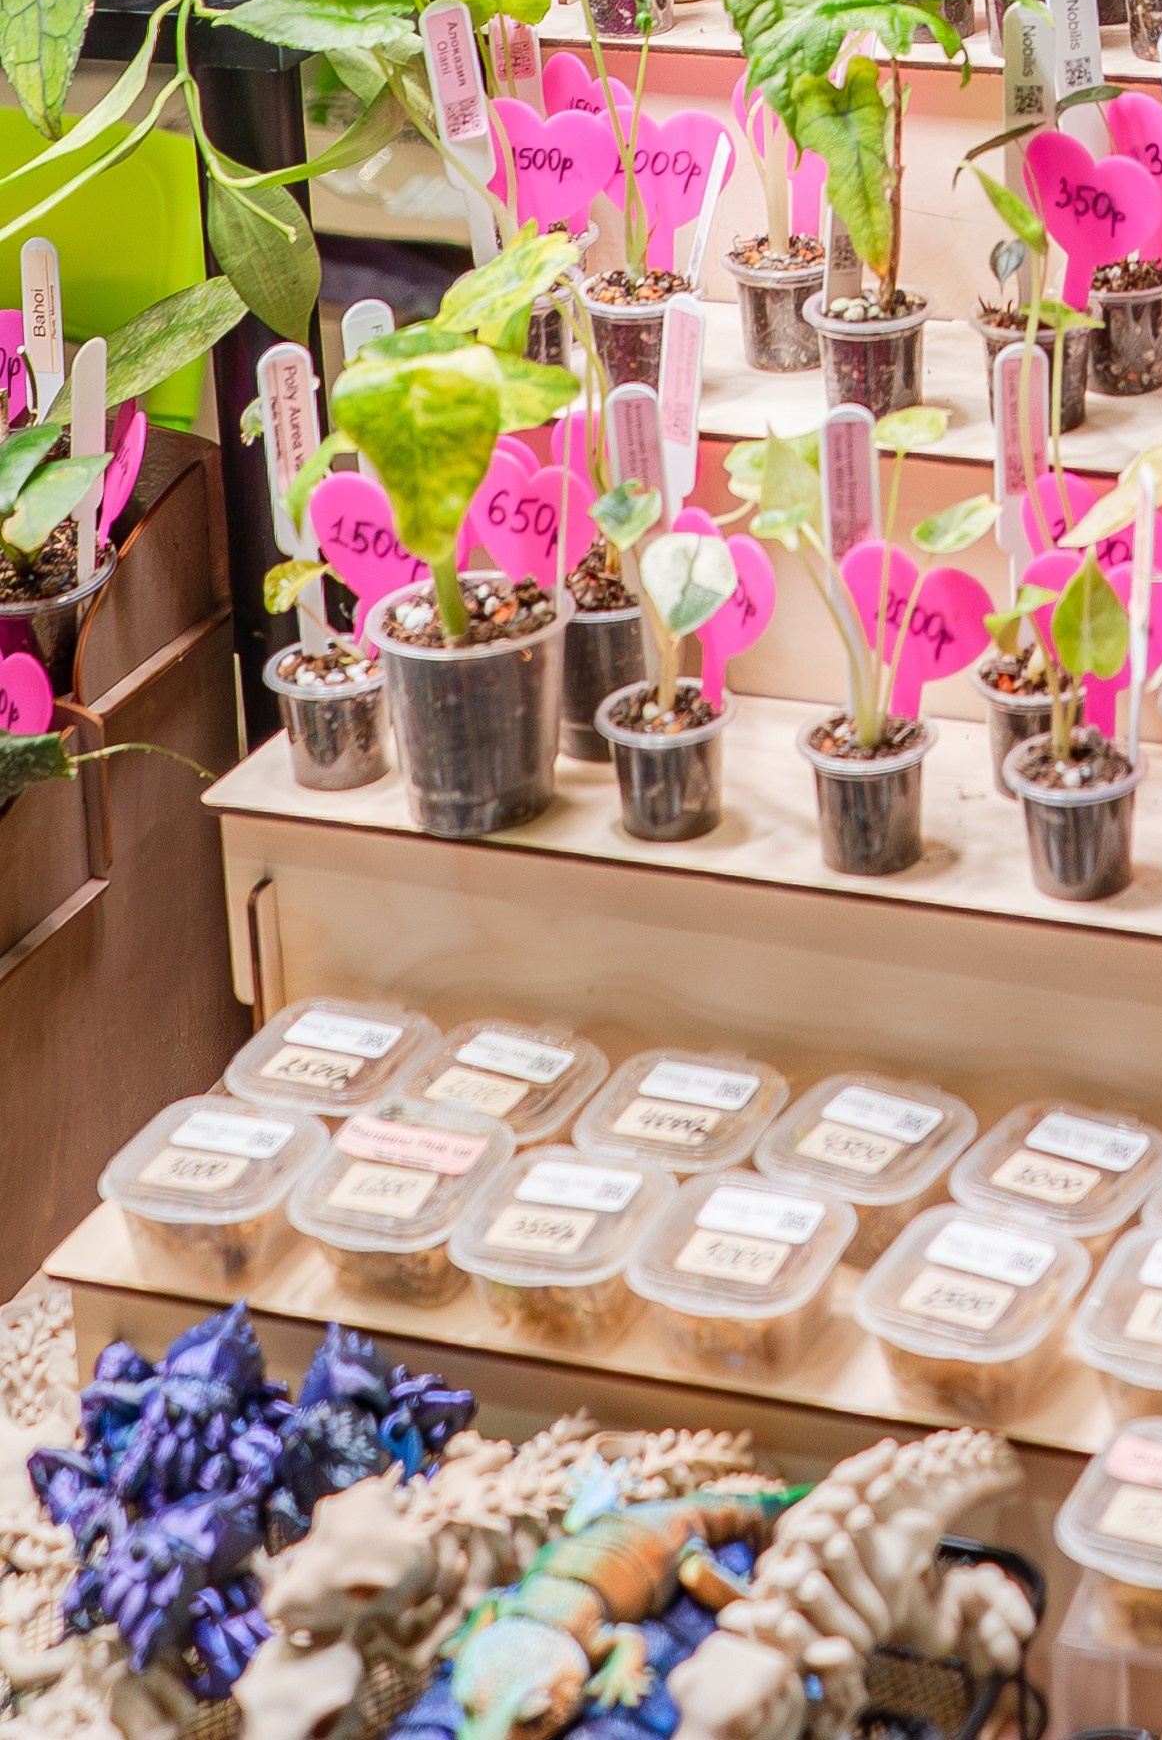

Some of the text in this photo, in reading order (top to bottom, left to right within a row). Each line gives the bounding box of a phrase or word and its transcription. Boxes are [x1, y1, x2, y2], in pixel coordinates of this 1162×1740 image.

[436, 39, 452, 77] Olani
[1021, 24, 1036, 77] Nobilis
[32, 286, 47, 338] Bahoi
[281, 365, 299, 404] Polly
[287, 406, 304, 446] Aurea
